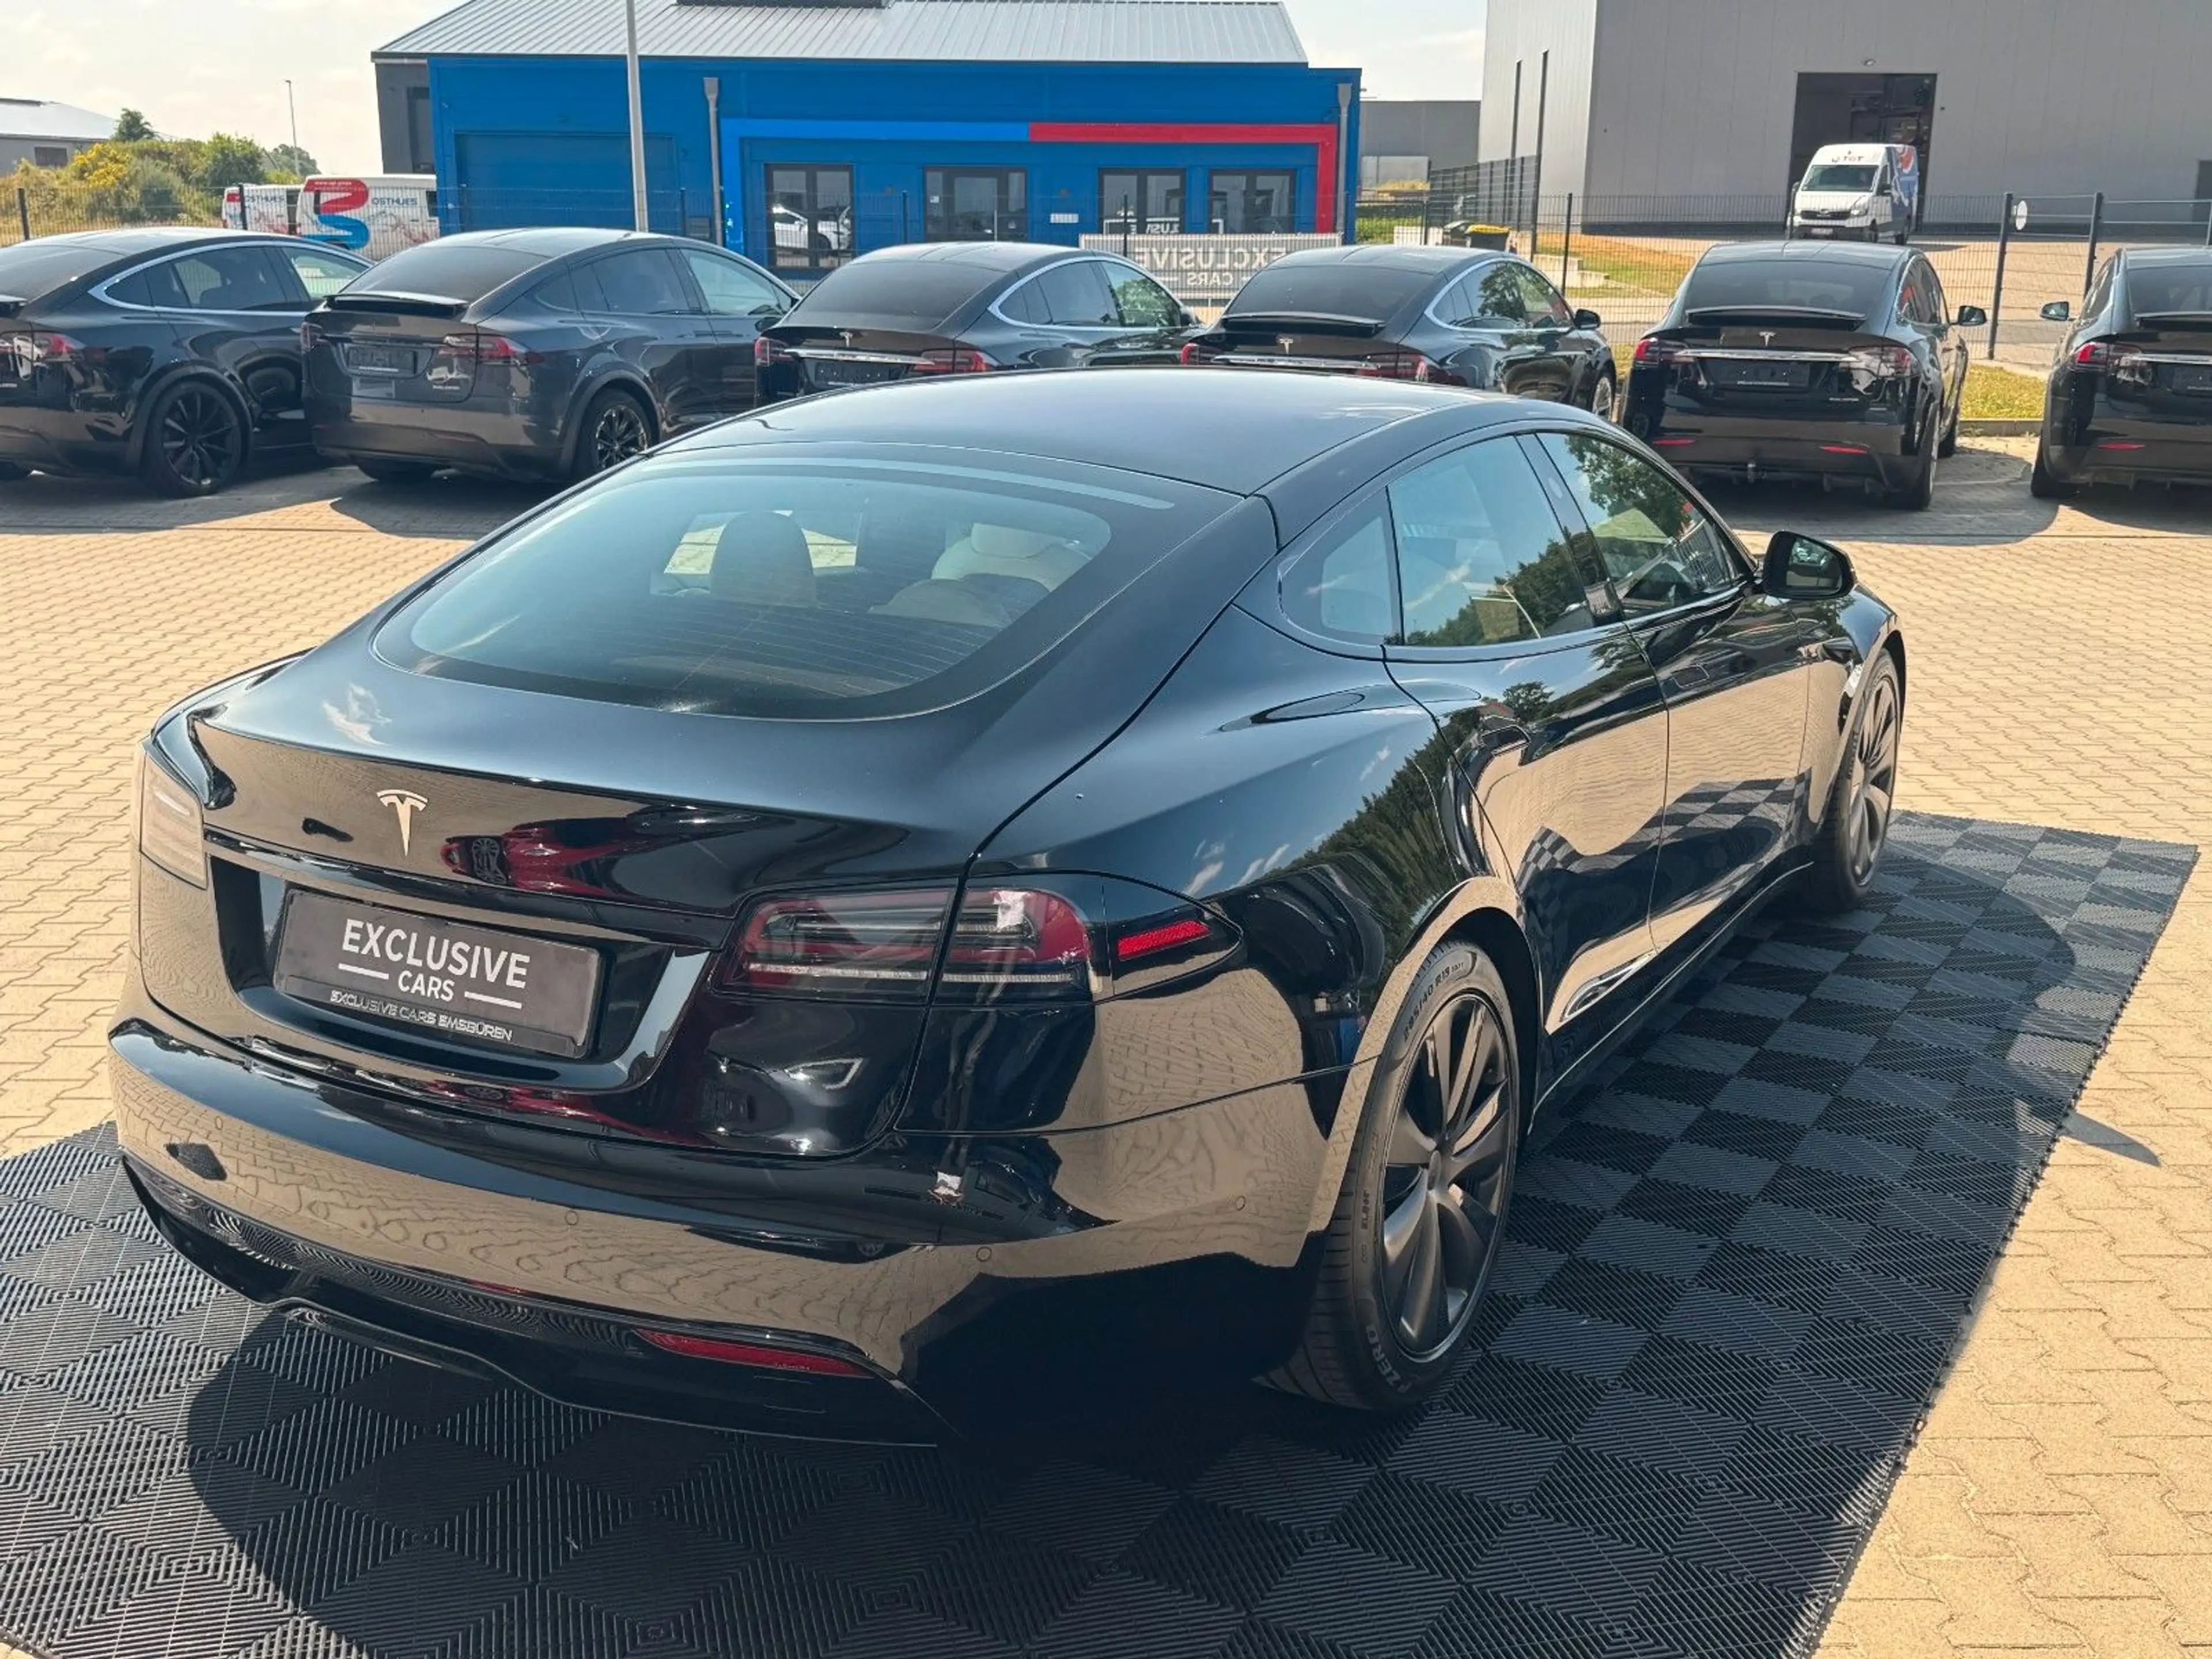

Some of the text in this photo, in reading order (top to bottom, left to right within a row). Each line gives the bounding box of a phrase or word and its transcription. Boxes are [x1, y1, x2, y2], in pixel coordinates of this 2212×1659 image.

[342, 918, 531, 988] EXCLUSIVE
[398, 970, 455, 1002] CARS
[330, 990, 513, 1041] EXCLUSIVE CARS EMSBÜREN
